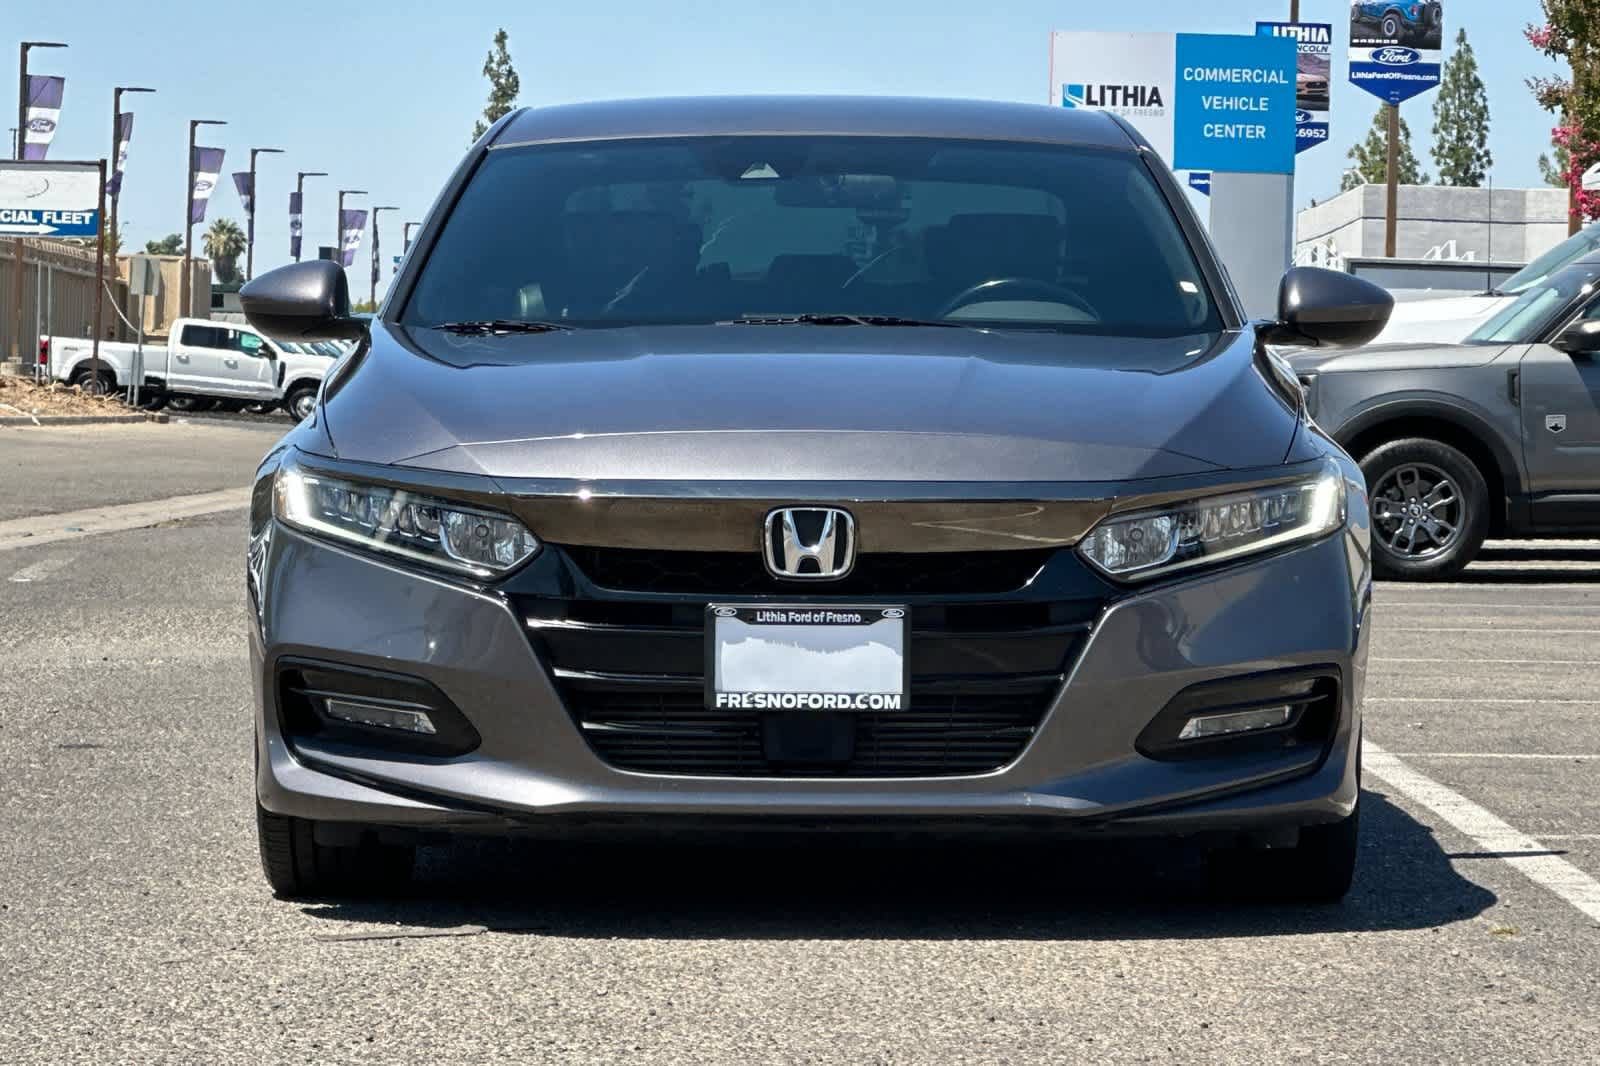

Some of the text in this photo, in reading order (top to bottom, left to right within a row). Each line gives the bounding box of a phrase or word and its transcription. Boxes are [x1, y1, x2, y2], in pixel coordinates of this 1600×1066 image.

[1273, 26, 1329, 42] LITHIA
[1380, 49, 1412, 63] Ford
[1183, 67, 1289, 84] COMMERCIAL
[1086, 85, 1164, 107] LITHIA
[1202, 96, 1269, 111] VEHICLE
[1203, 124, 1266, 139] CENTER
[0, 210, 94, 225] CIAL FLEET
[756, 611, 862, 623] Lithia Ford of Fresno
[716, 693, 901, 710] FRESNOFORD.COM
